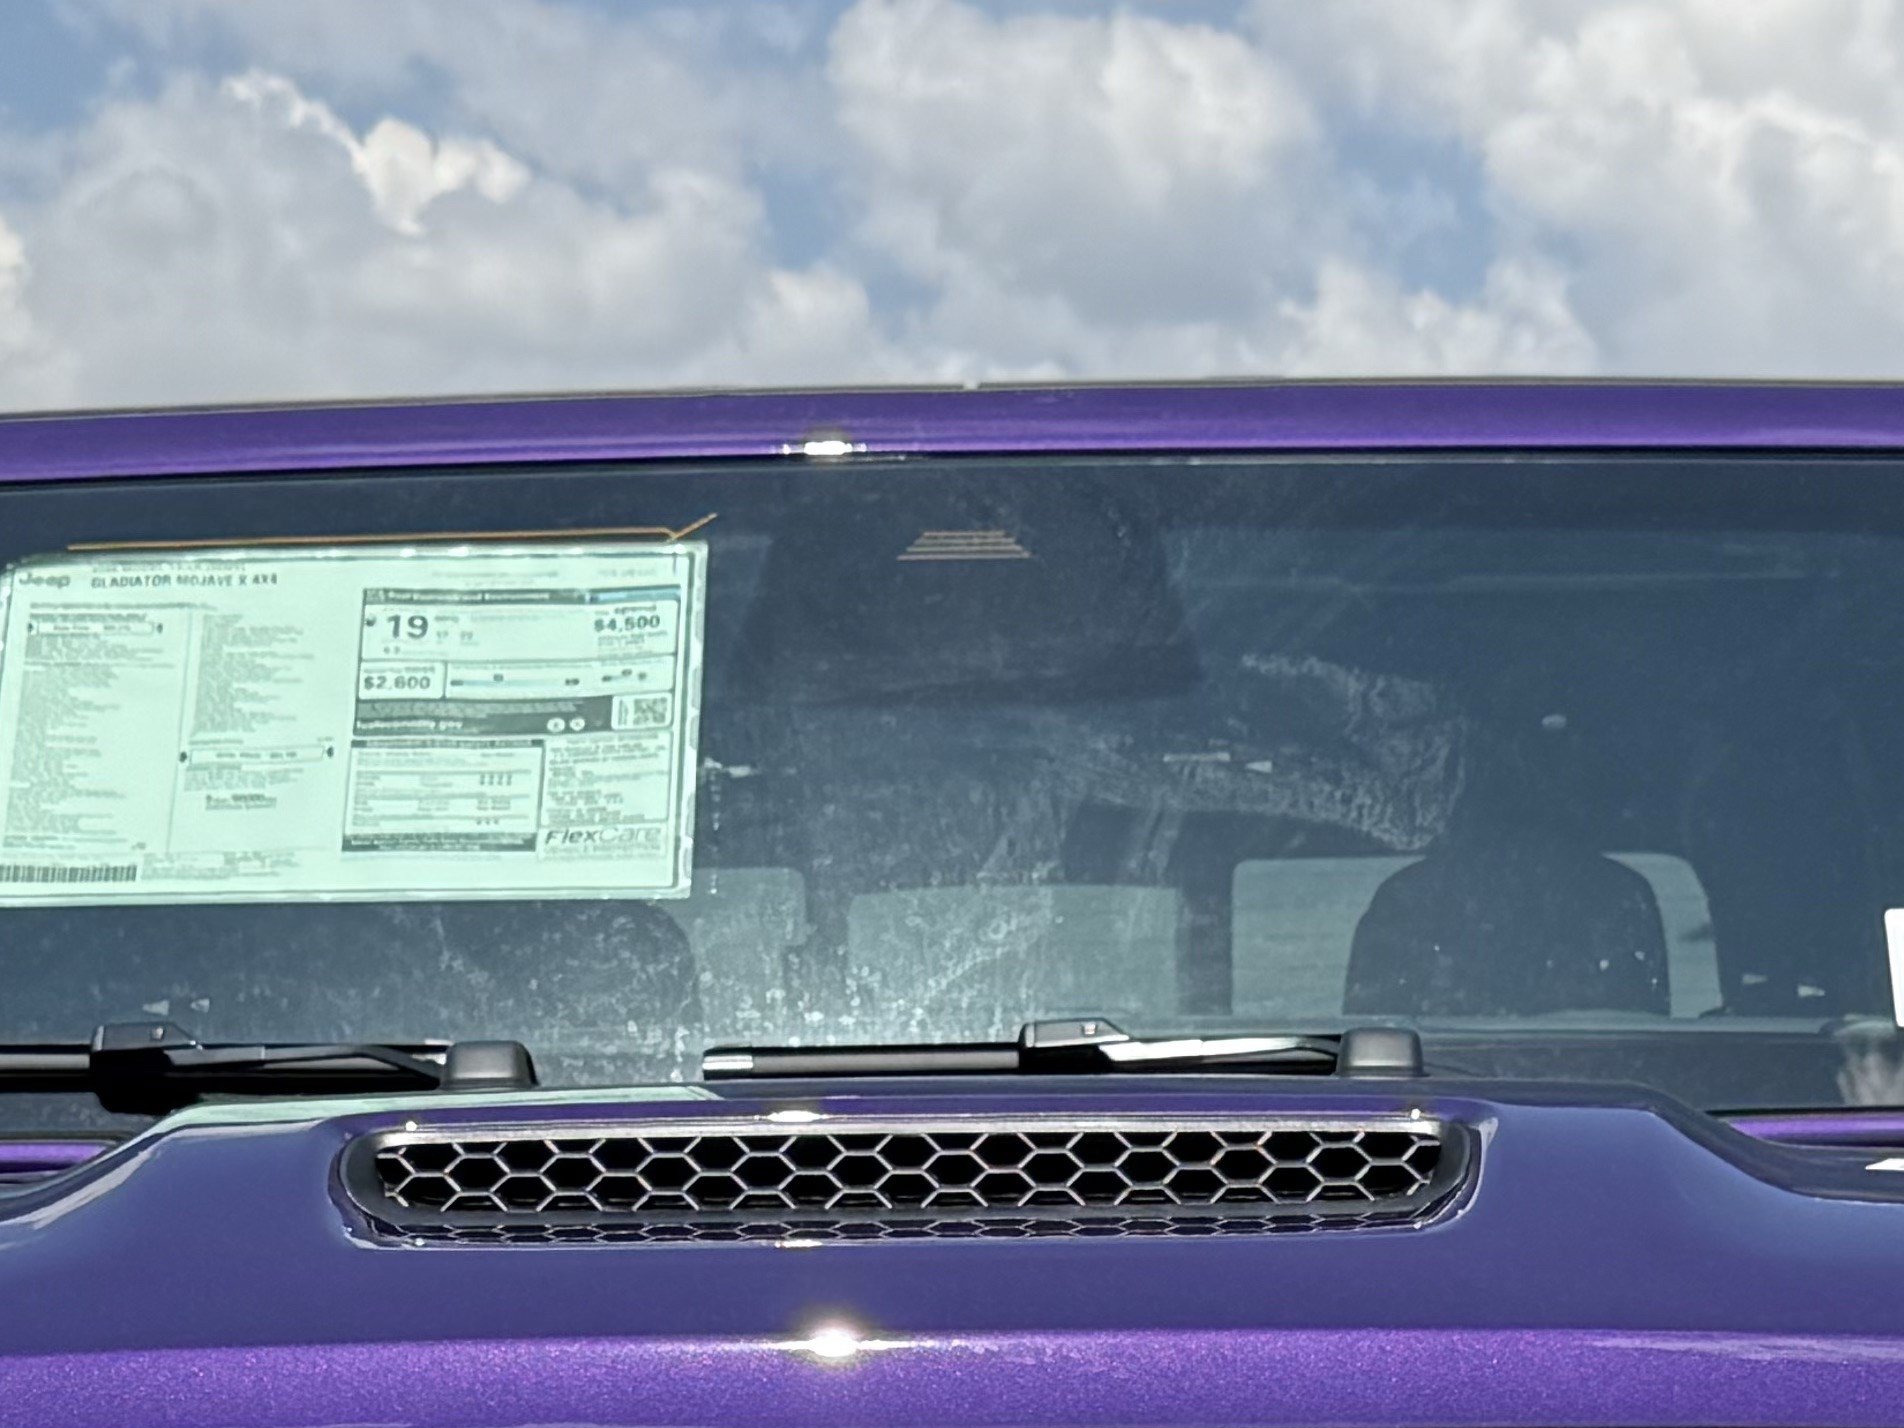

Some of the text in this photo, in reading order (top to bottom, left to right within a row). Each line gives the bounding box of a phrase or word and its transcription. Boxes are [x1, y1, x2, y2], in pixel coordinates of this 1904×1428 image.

[19, 573, 71, 589] Jeep
[90, 574, 172, 589] GLADIATOR
[176, 574, 233, 587] MOJAVE
[387, 614, 429, 639] 19
[594, 614, 661, 632] $4,500
[364, 675, 431, 690] $2,600
[546, 827, 662, 845] FlexCare
